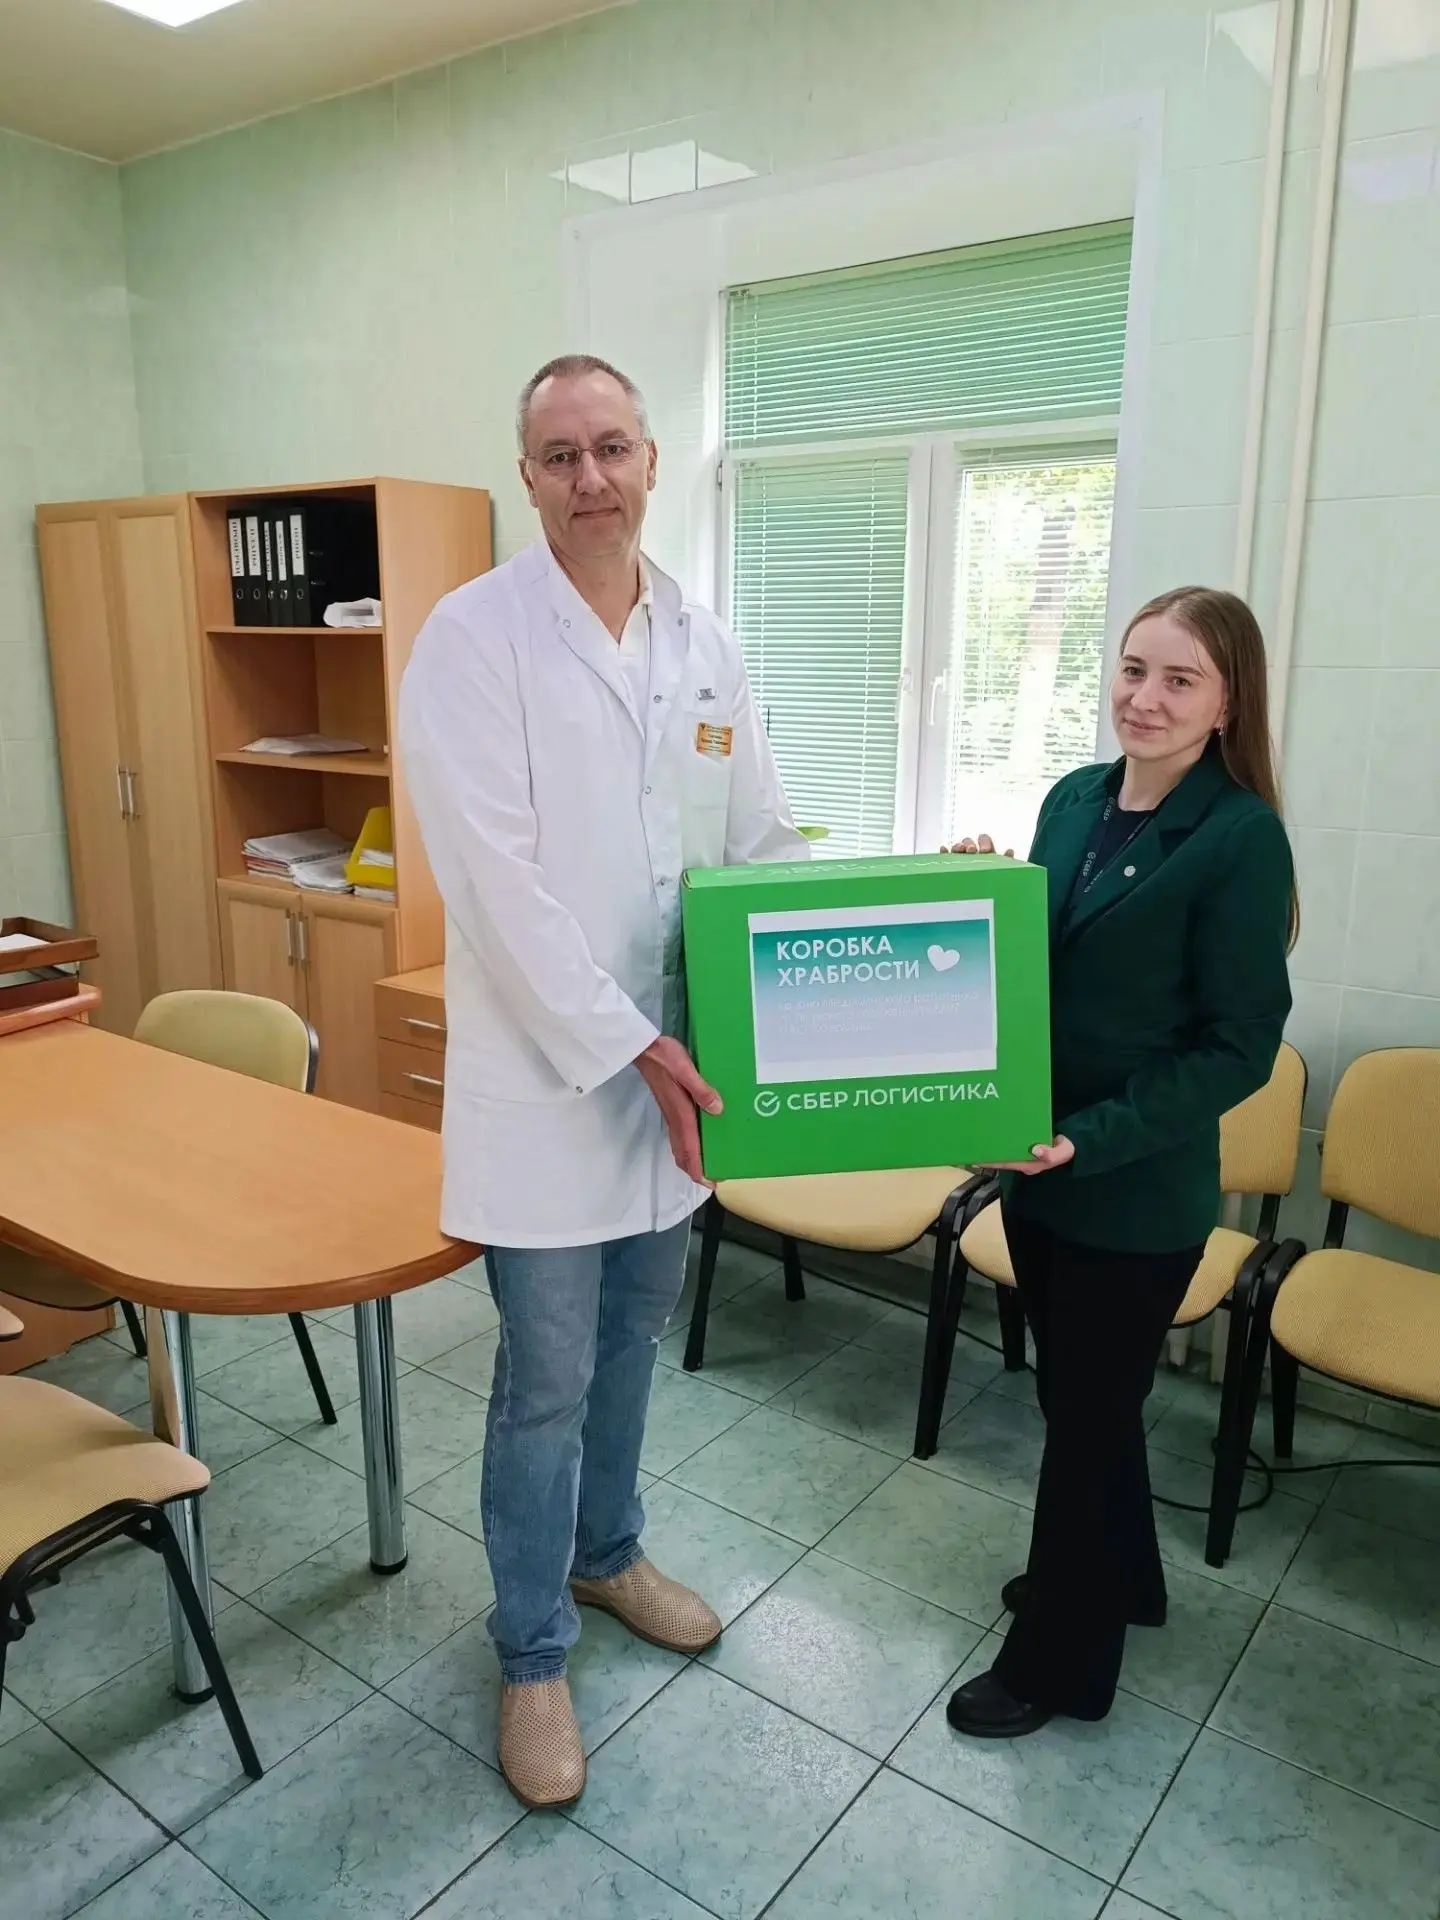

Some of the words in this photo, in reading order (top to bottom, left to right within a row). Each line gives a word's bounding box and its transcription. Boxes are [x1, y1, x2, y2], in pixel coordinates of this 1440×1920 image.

[776, 936, 894, 961] КОРОБКА
[777, 960, 921, 987] ХРАБРОСТИ
[786, 1091, 849, 1111] СБЕР
[853, 1082, 1000, 1107] ЛОГИСТИКА
